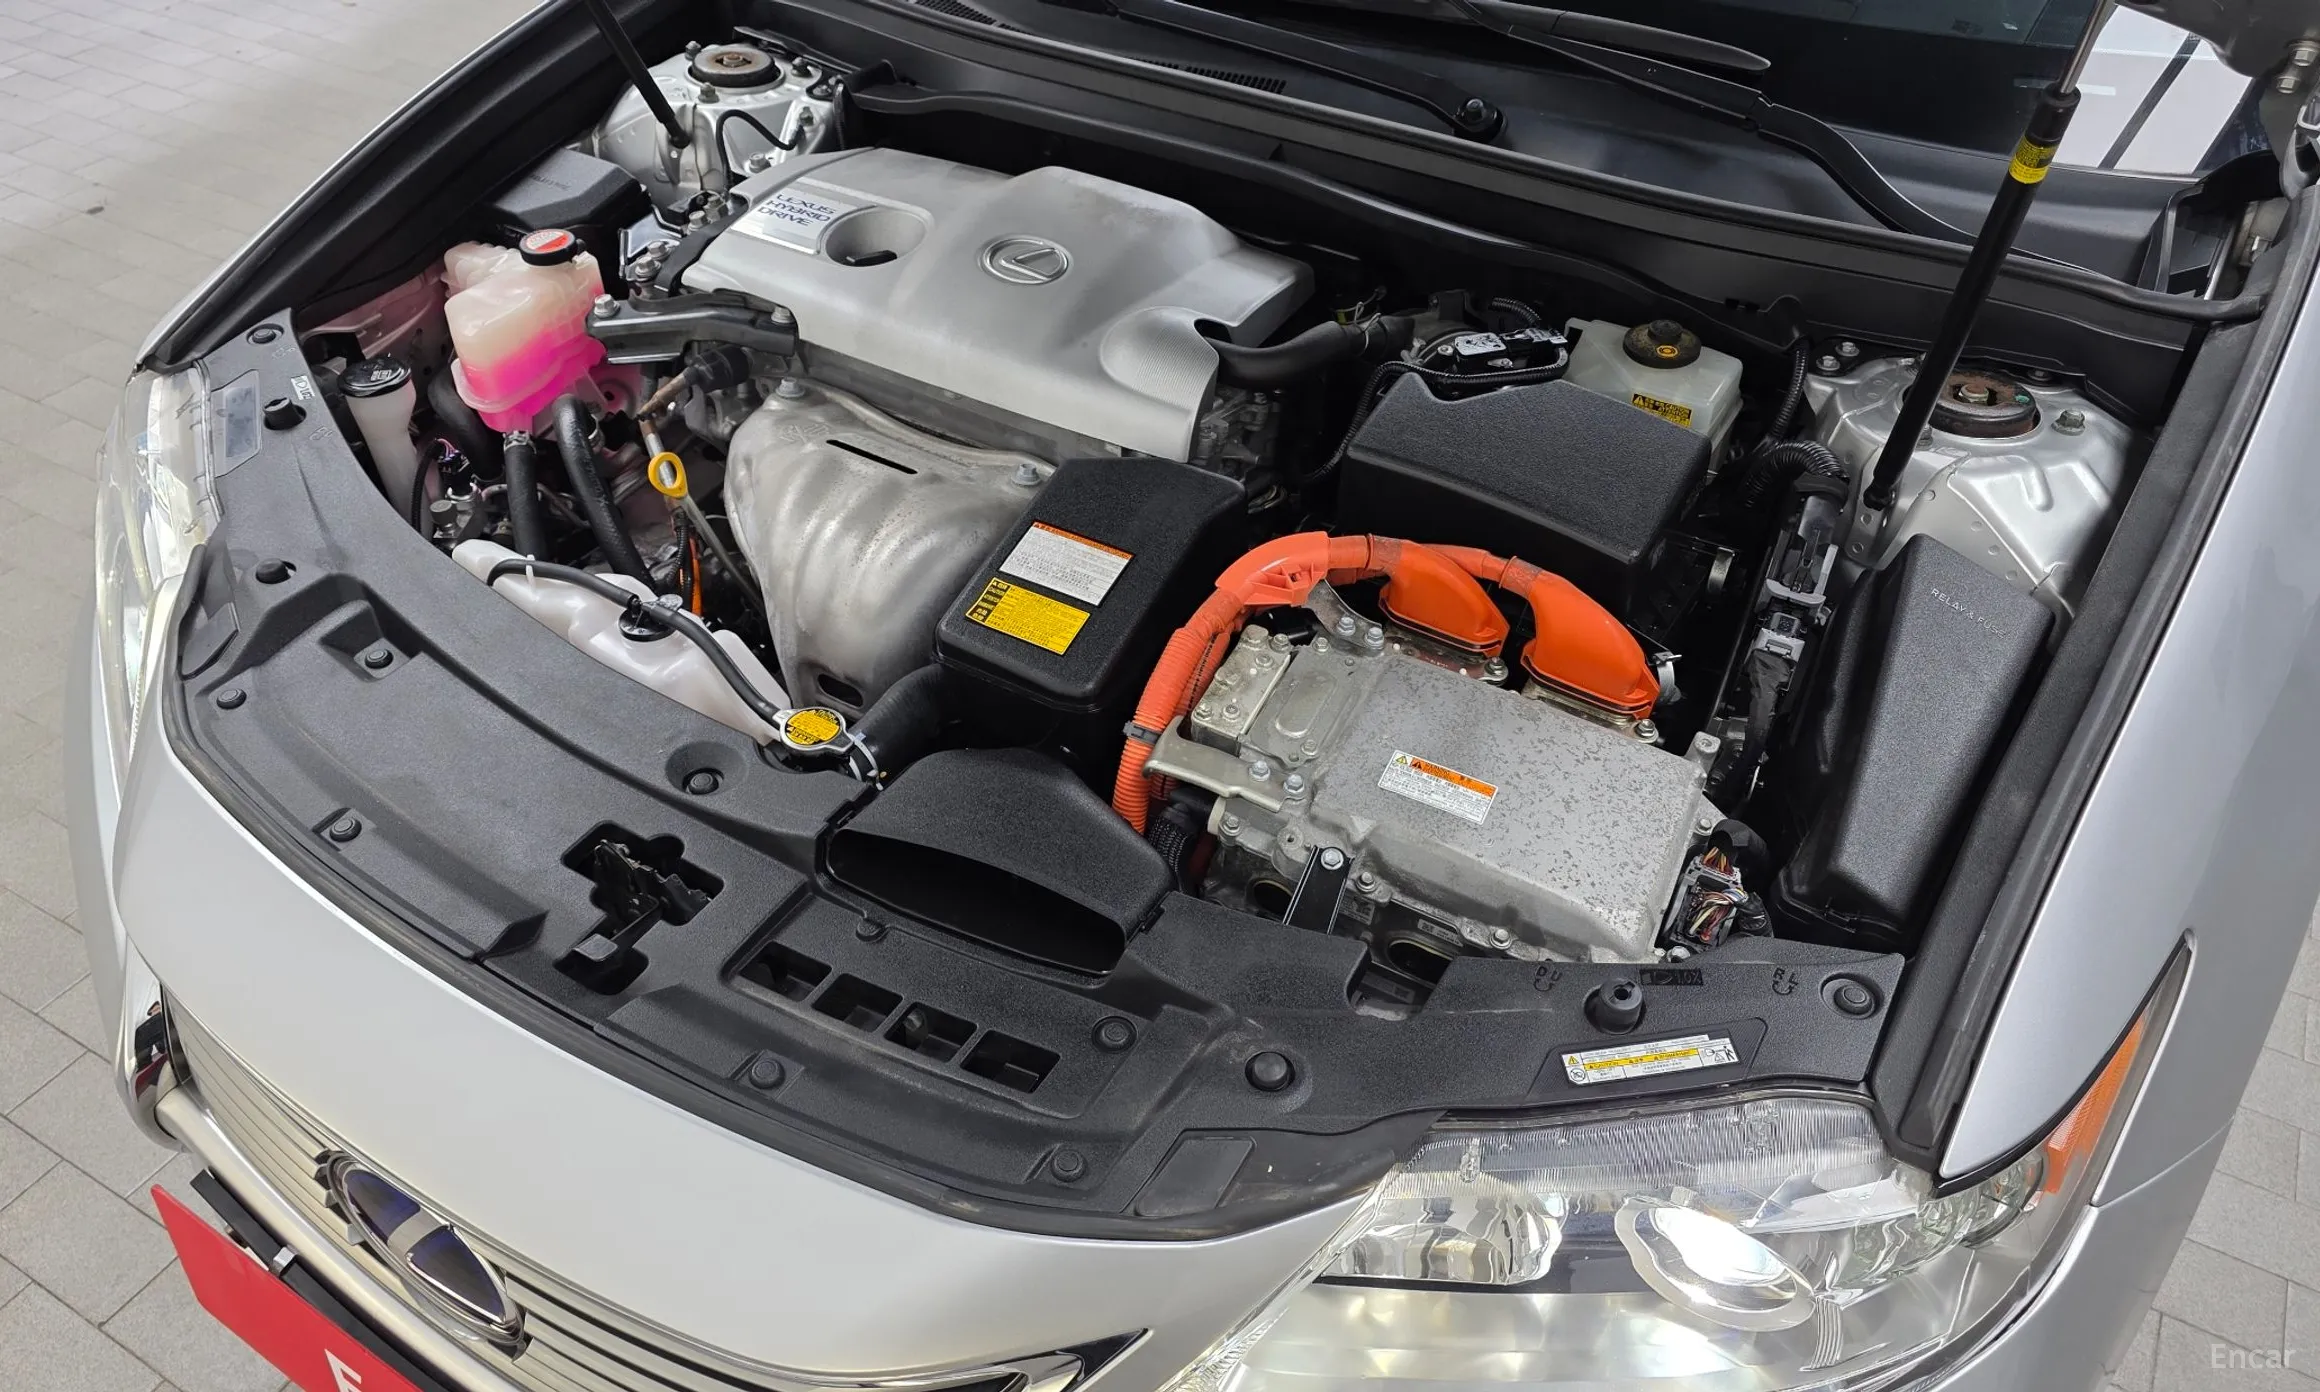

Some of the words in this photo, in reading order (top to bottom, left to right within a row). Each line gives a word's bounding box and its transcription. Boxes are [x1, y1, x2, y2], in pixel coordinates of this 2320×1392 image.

[766, 200, 831, 221] HYBRID
[777, 194, 836, 214] LEXUS
[758, 206, 813, 226] DRIVE
[1931, 588, 1966, 611] RELAY
